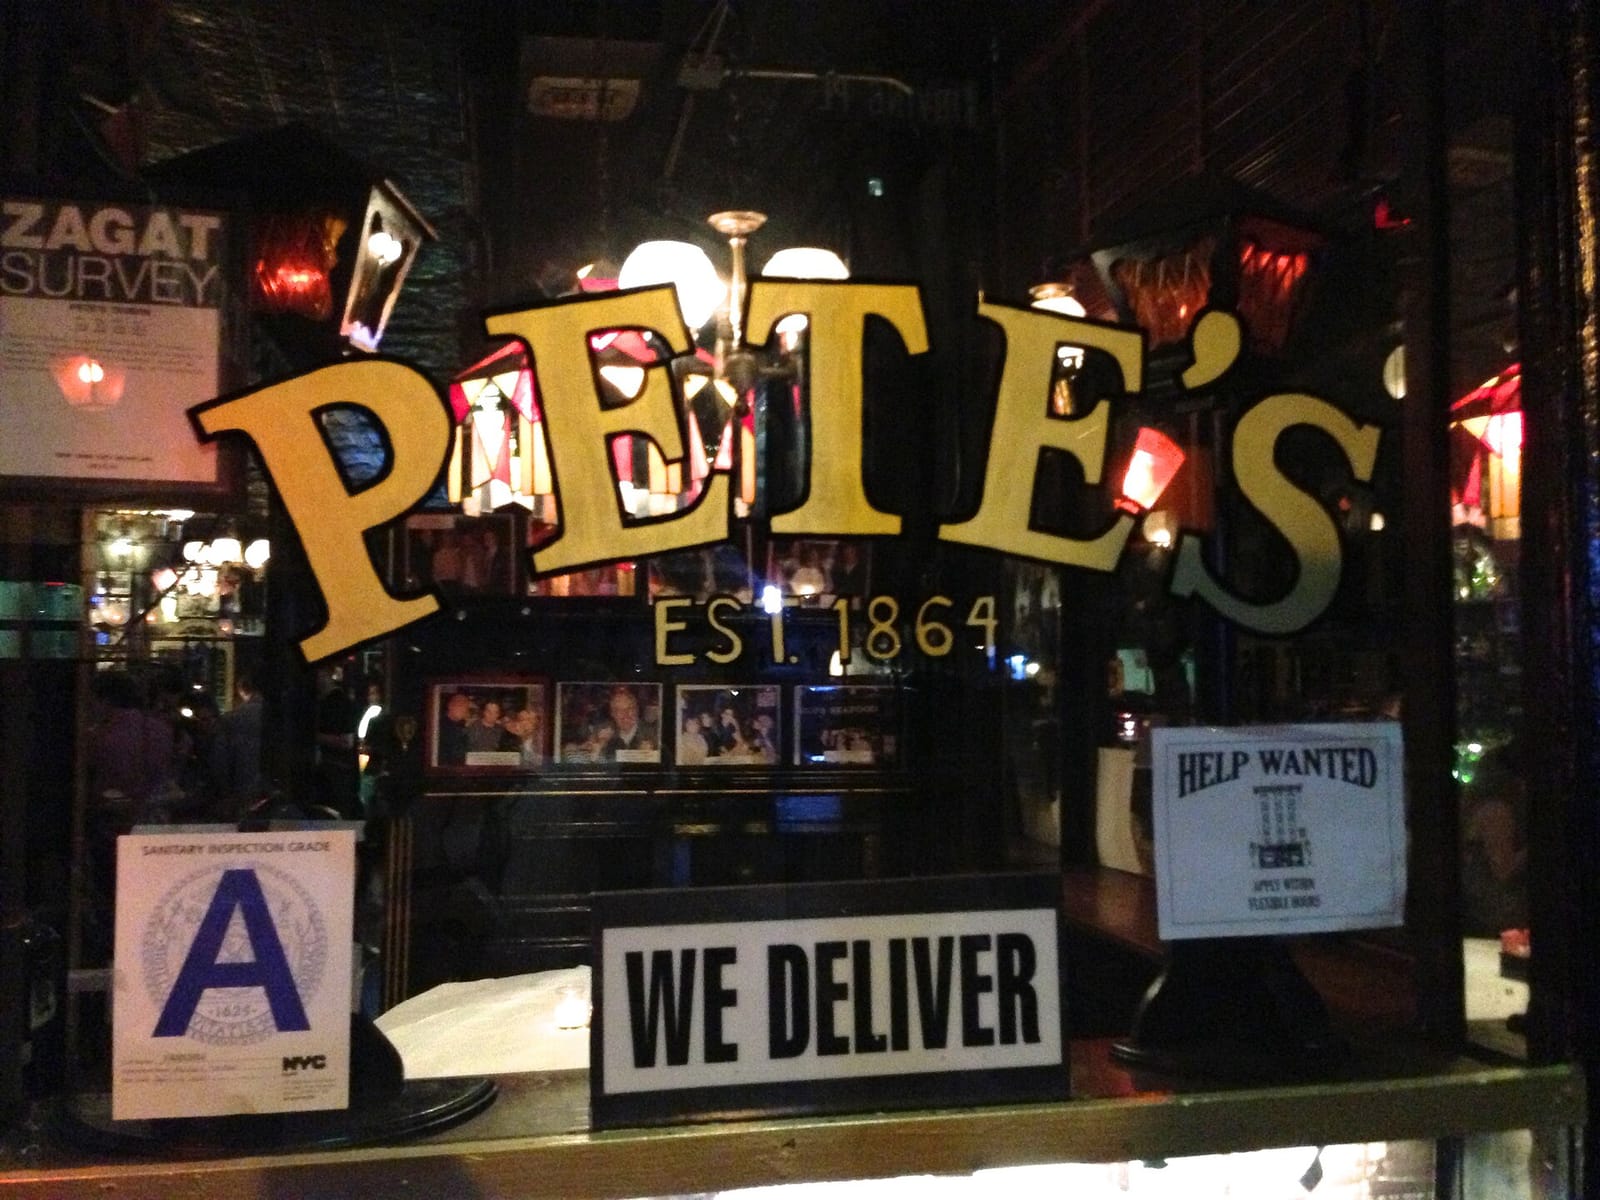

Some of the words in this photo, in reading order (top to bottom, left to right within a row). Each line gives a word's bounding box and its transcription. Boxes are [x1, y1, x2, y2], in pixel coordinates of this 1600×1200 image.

[1, 201, 221, 261] ZAGAT
[0, 252, 220, 304] SURVEY
[195, 281, 1382, 664] PETE'S
[654, 598, 799, 666] EST.
[832, 596, 999, 663] 1864
[1177, 751, 1250, 799] HELP
[1257, 747, 1379, 790] WANTED
[143, 844, 204, 857] SANITARY
[207, 842, 285, 855] INSPECTION
[289, 841, 331, 853] GRADE
[151, 868, 312, 1038] A
[624, 946, 739, 1069] WE
[767, 932, 1041, 1060] DELIVER
[281, 1054, 328, 1073] NYC
